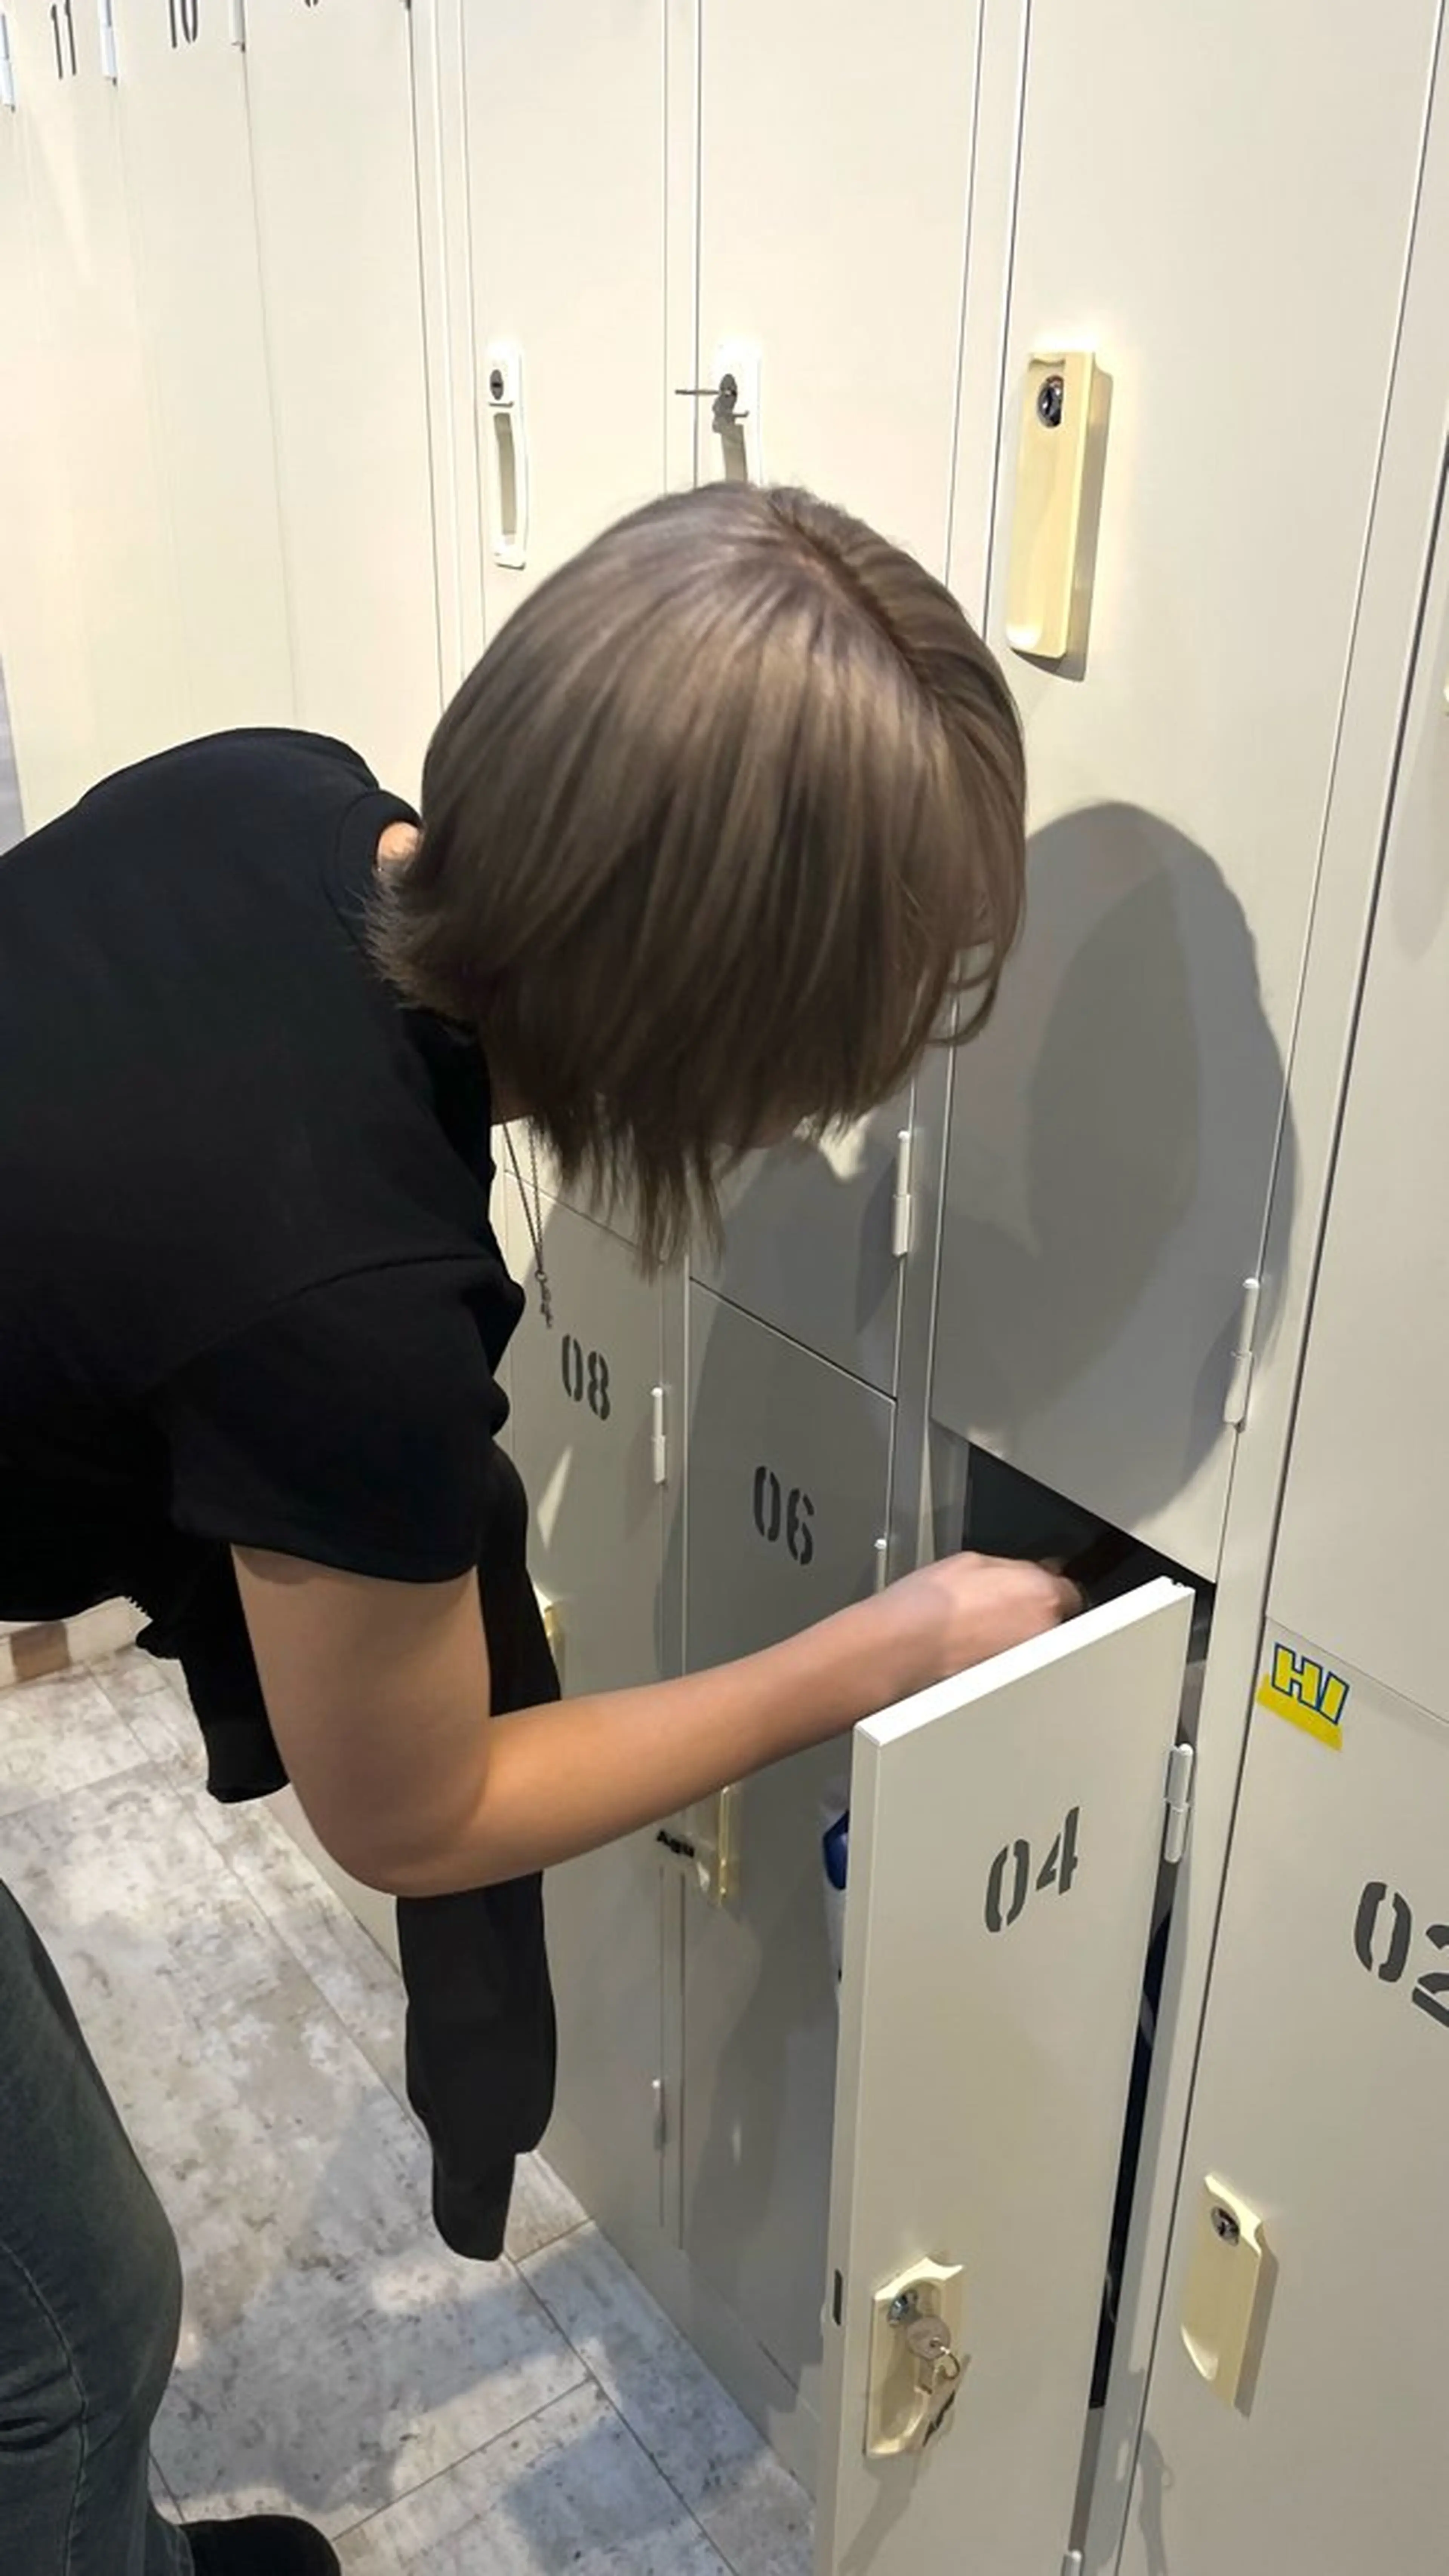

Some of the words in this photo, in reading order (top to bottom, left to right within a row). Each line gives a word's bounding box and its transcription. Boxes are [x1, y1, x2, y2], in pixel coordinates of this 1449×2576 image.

[561, 1333, 611, 1421] 08
[754, 1465, 814, 1566] 06
[1271, 1642, 1350, 1726] HI
[985, 1806, 1080, 1932] 04
[1354, 1881, 1449, 2028] 02
